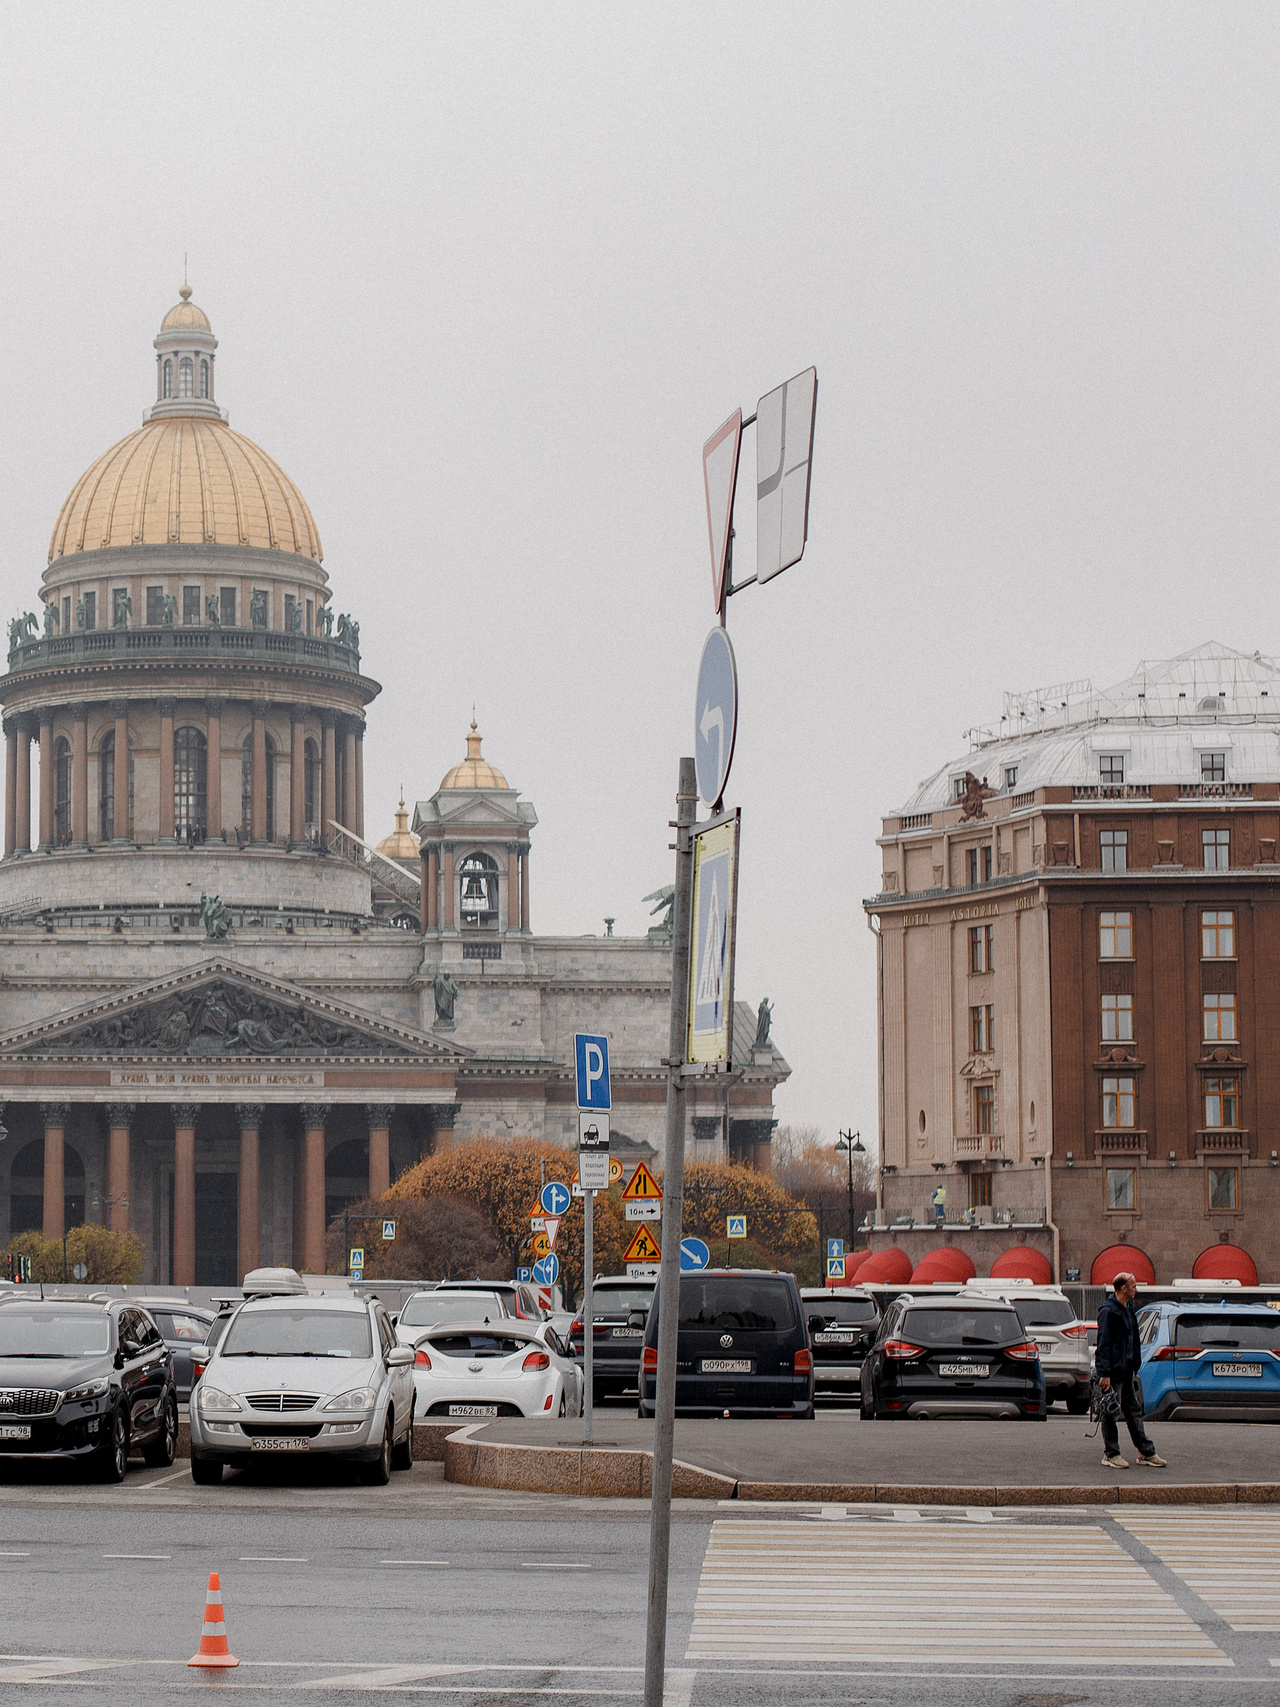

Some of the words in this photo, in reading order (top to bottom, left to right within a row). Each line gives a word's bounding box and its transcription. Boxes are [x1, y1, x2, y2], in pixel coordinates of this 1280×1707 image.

[903, 913, 930, 927] HOTEL
[950, 903, 1000, 921] ASTORIA
[585, 1042, 604, 1101] P
[521, 1269, 529, 1280] P
[1215, 1364, 1247, 1373] К673РО
[255, 1439, 290, 1449] О355СТ
